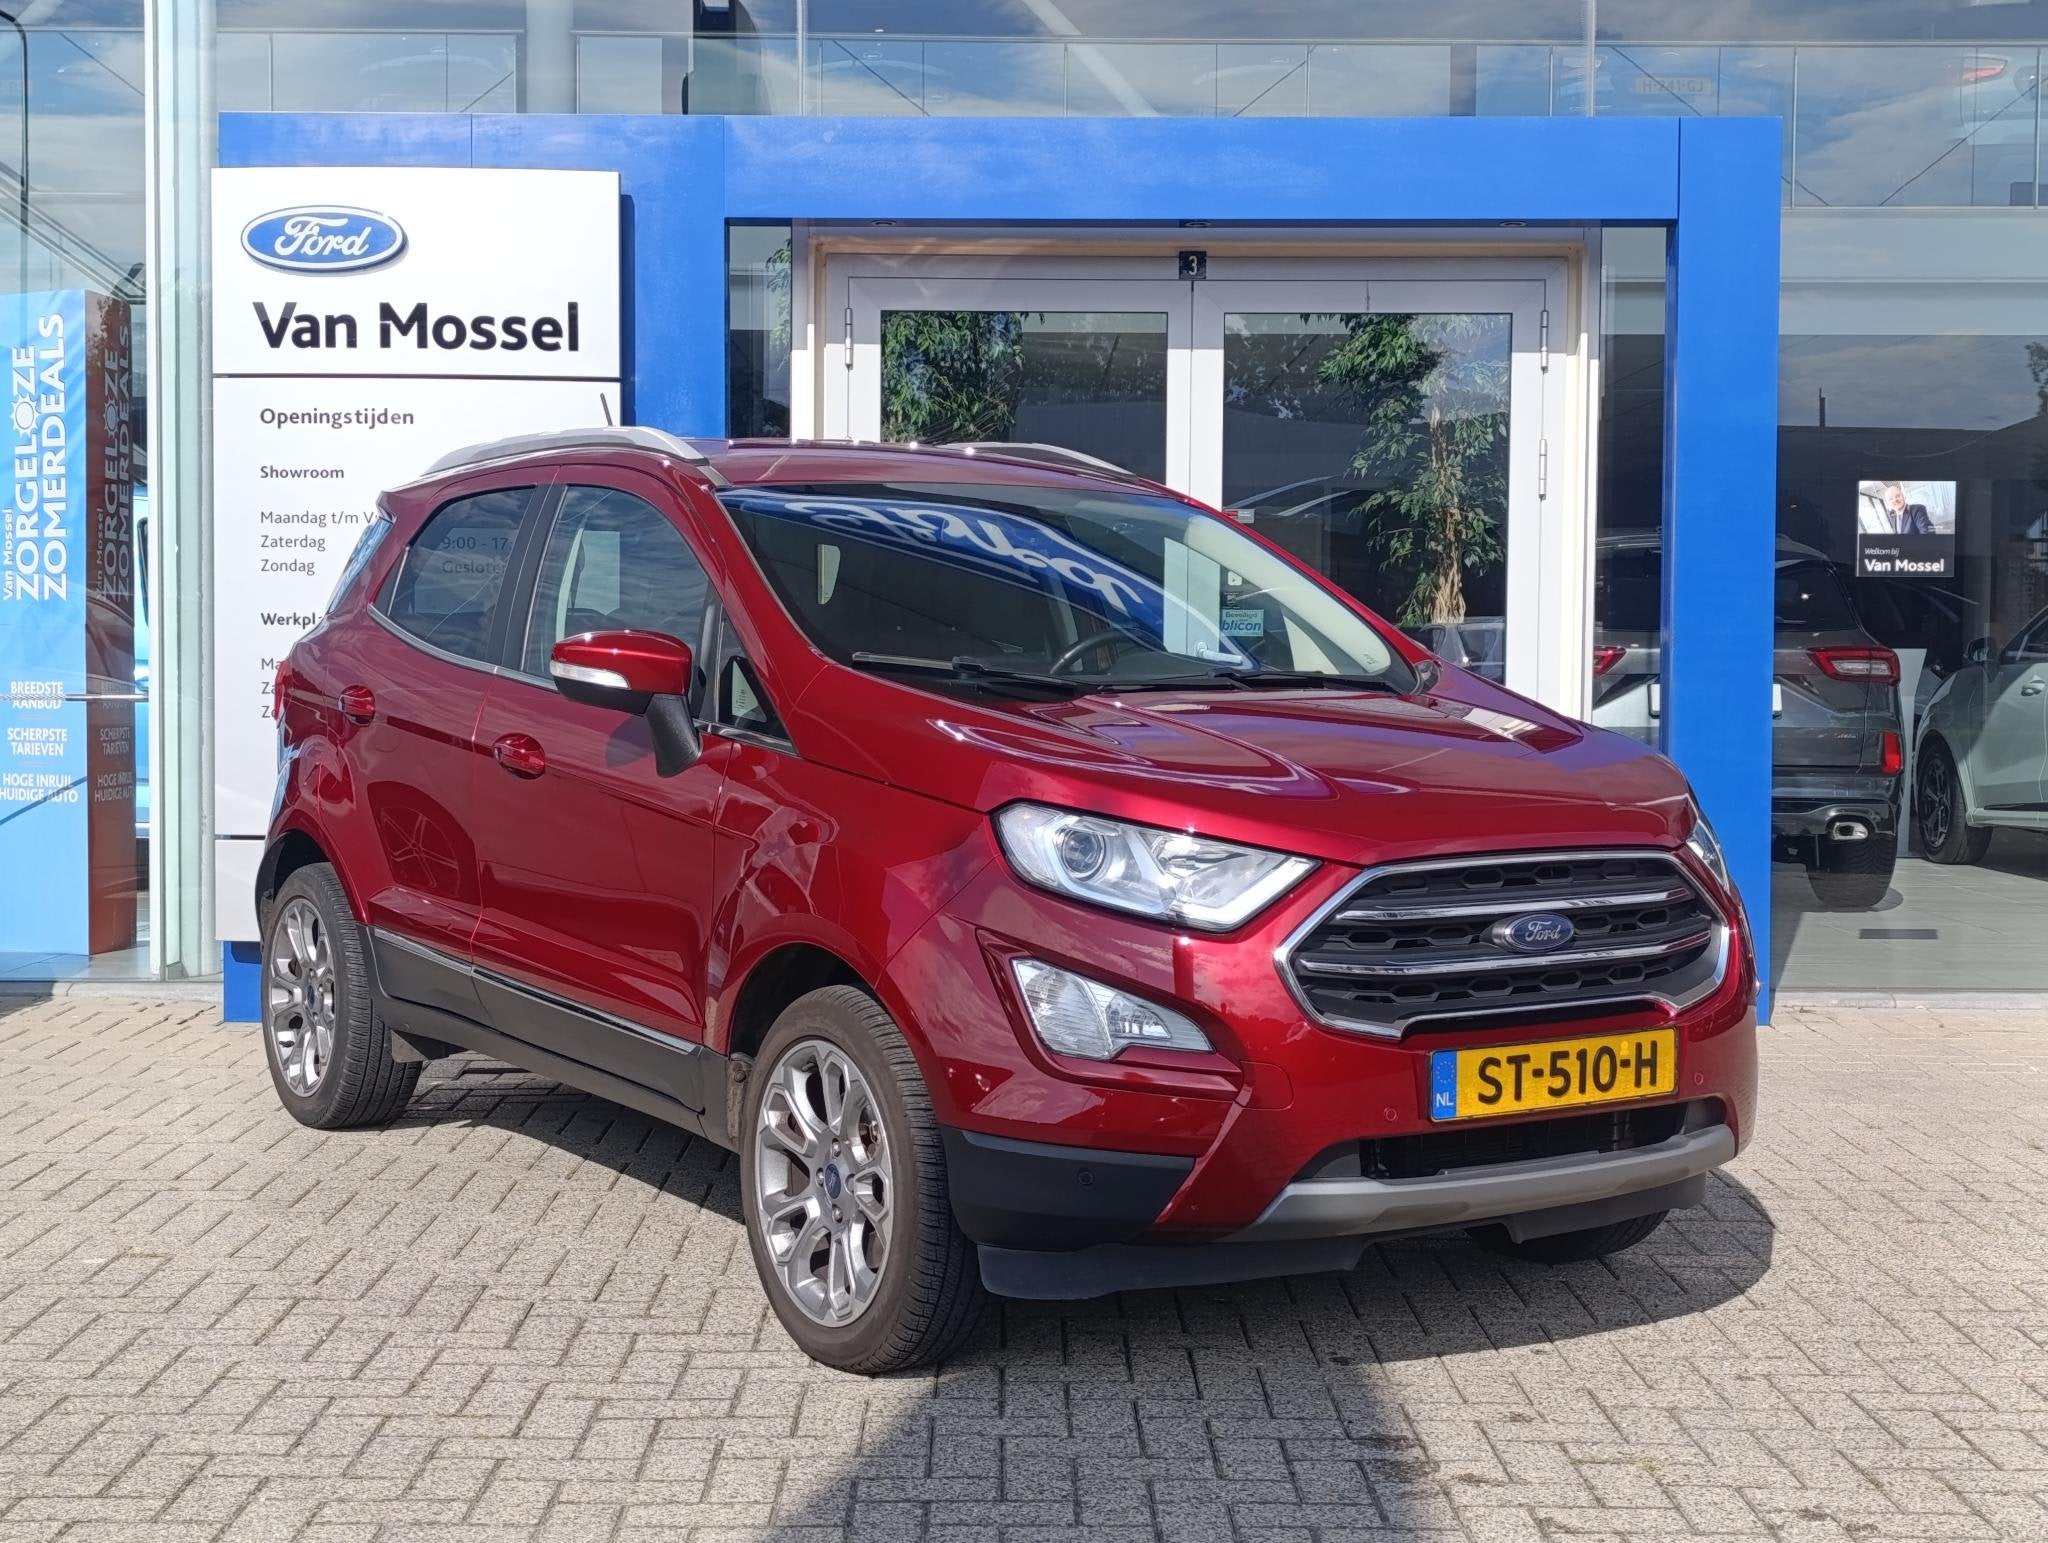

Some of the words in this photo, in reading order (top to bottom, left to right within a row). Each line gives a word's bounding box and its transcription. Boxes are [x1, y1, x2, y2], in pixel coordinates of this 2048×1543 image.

[274, 214, 372, 257] Ford
[1188, 255, 1198, 276] 3
[252, 301, 358, 349] Van
[379, 302, 580, 353] Mossel
[259, 407, 415, 430] Openingstijden
[38, 313, 68, 601] ZOMERDEALS
[260, 465, 345, 479] Showroom
[260, 510, 327, 528] Maandag
[331, 510, 359, 525] t/m
[363, 511, 378, 524] V
[3, 507, 14, 566] Mossel
[260, 534, 326, 552] Zaterdag
[1864, 547, 1890, 556] Welkom
[1891, 547, 1900, 557] bij
[260, 558, 315, 576] Zondag
[1864, 558, 1891, 573] Van
[1895, 558, 1945, 573] Mossel
[3, 570, 14, 600] Van
[10, 681, 64, 695] BREEDSTE
[7, 727, 68, 741] SCHERPSTE
[11, 742, 65, 757] TARIEVEN
[2, 773, 35, 786] HOGE
[0, 787, 46, 801] HUIDIGE
[1477, 1040, 1658, 1105] ST-510-H
[1436, 1091, 1455, 1107] NL
